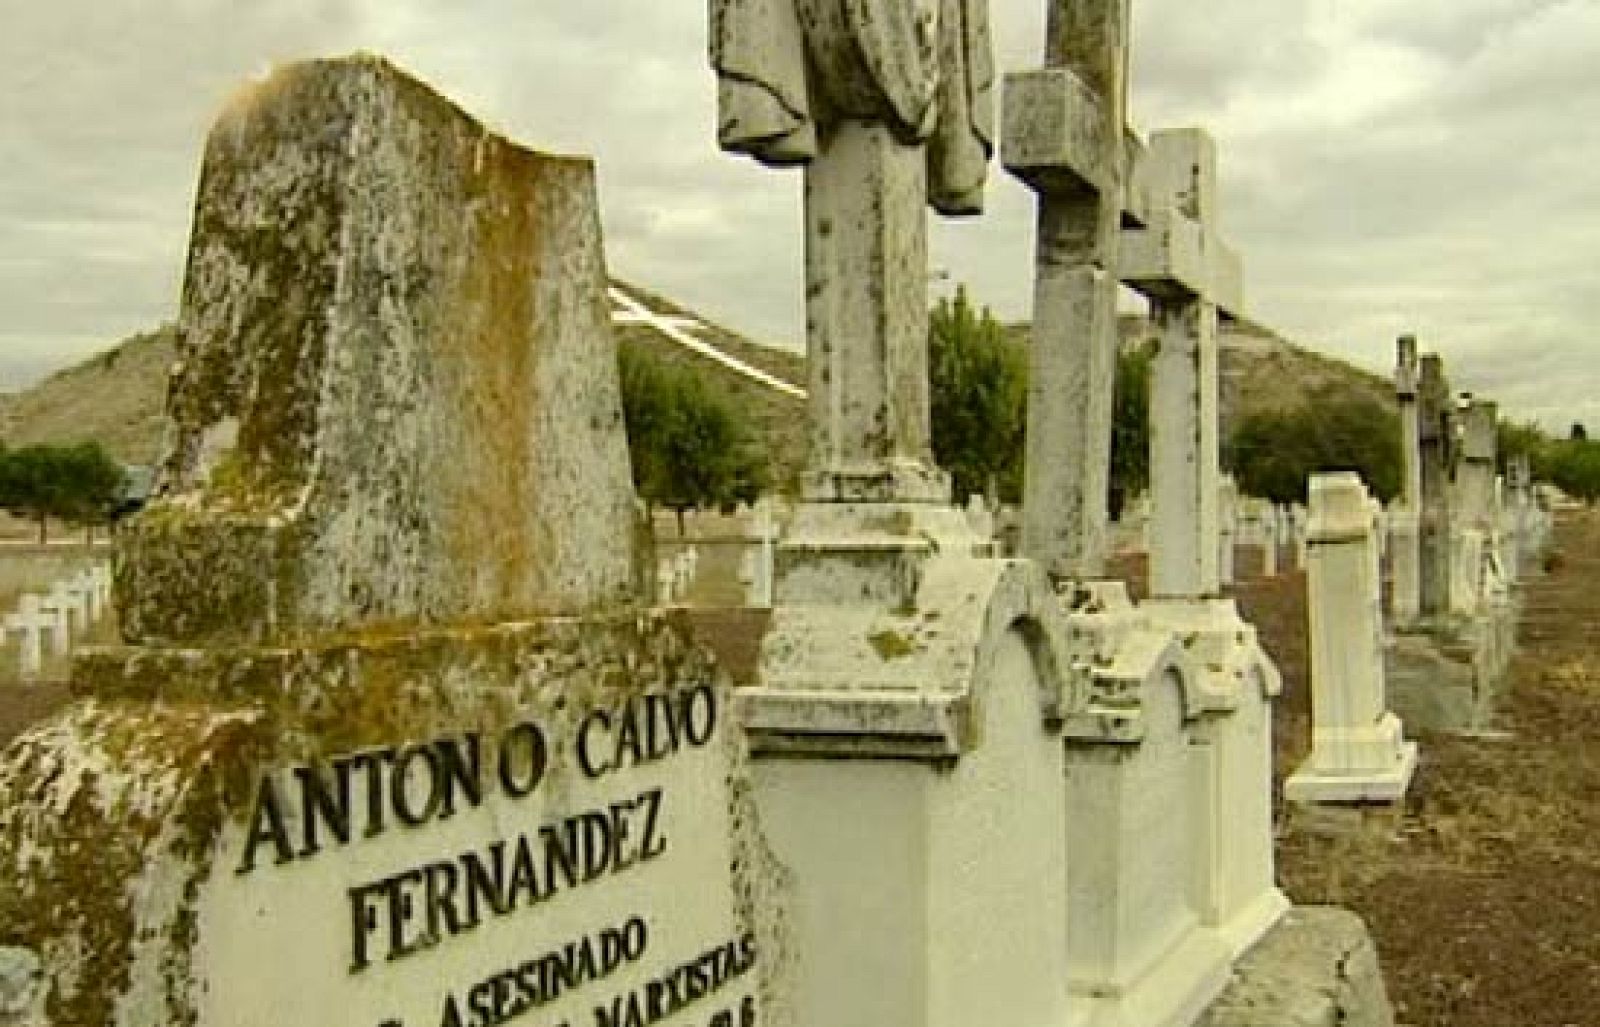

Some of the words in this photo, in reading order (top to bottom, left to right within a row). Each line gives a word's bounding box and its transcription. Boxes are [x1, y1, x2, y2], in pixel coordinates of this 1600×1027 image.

[577, 685, 717, 779] CALVO
[347, 788, 666, 974] FERNANDEZ
[441, 915, 648, 1027] ASESINADO
